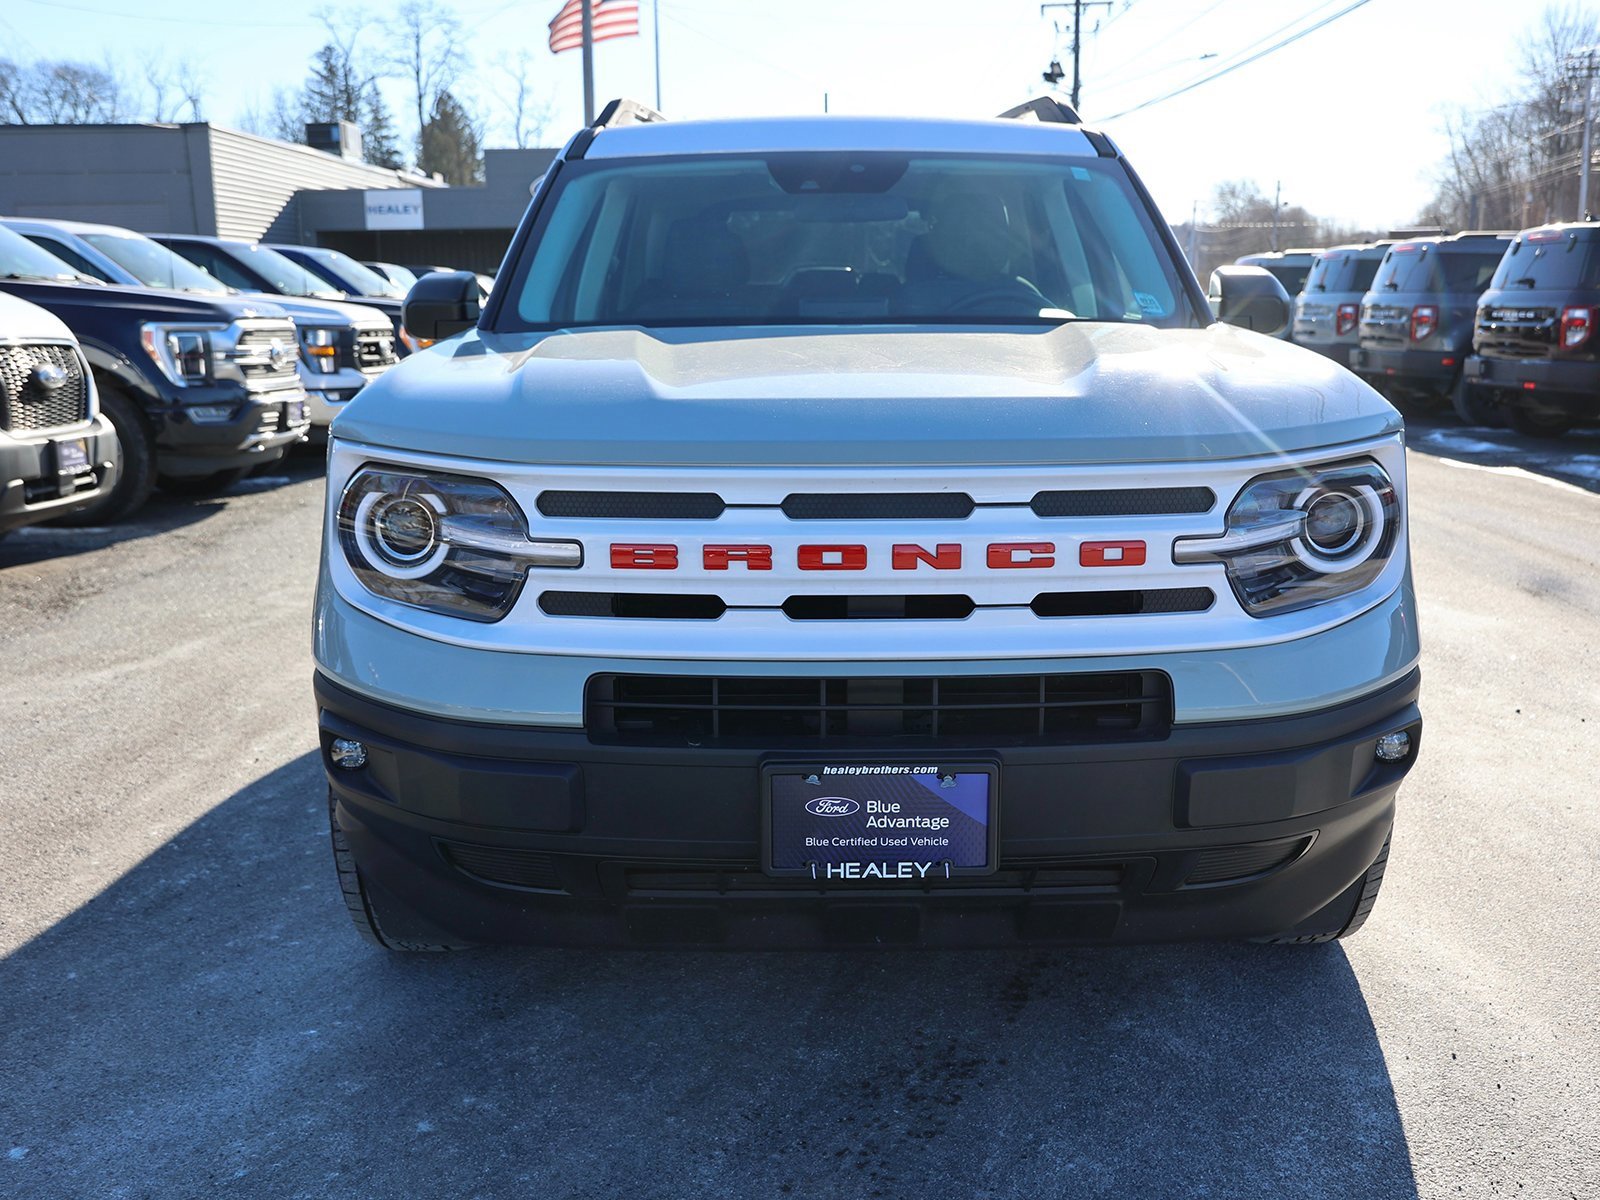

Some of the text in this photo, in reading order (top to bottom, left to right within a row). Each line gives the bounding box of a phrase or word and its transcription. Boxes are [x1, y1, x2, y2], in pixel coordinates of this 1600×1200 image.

[368, 205, 420, 215] HEALEY
[610, 540, 1147, 570] BRONCO
[823, 766, 938, 776] healeybrothers.com
[814, 799, 850, 815] Ford
[866, 800, 901, 813] Blue
[866, 815, 950, 830] Advantage
[805, 837, 949, 847] Blue Certified Used Vehicle
[827, 862, 932, 879] HEALEY
